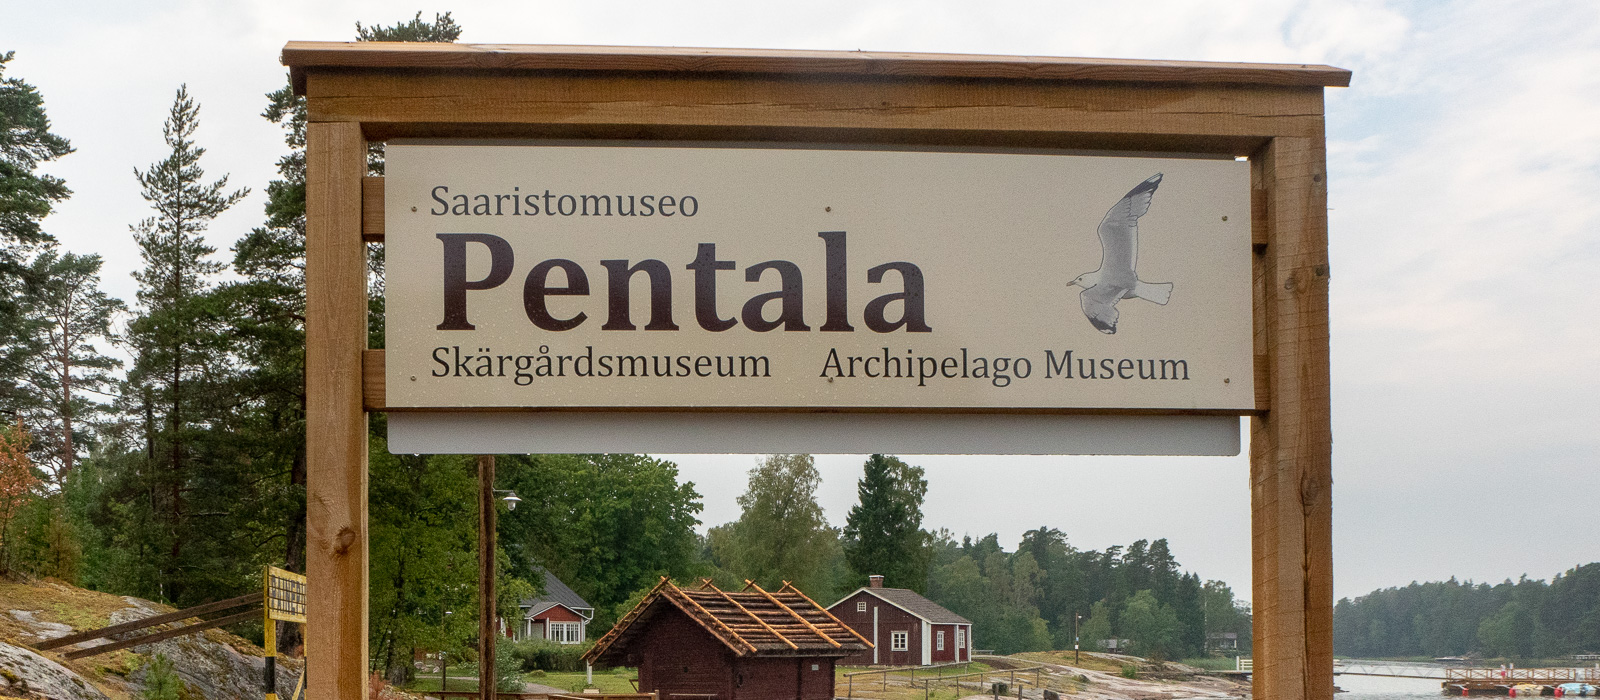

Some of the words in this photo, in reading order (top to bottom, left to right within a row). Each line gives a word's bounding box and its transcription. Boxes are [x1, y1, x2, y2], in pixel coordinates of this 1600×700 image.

[431, 185, 699, 217] Saaristomuseo
[435, 231, 933, 334] Pentala
[431, 345, 772, 387] Skärgårdsmuseum
[819, 347, 1032, 388] Archipelago
[1044, 349, 1190, 381] Museum
